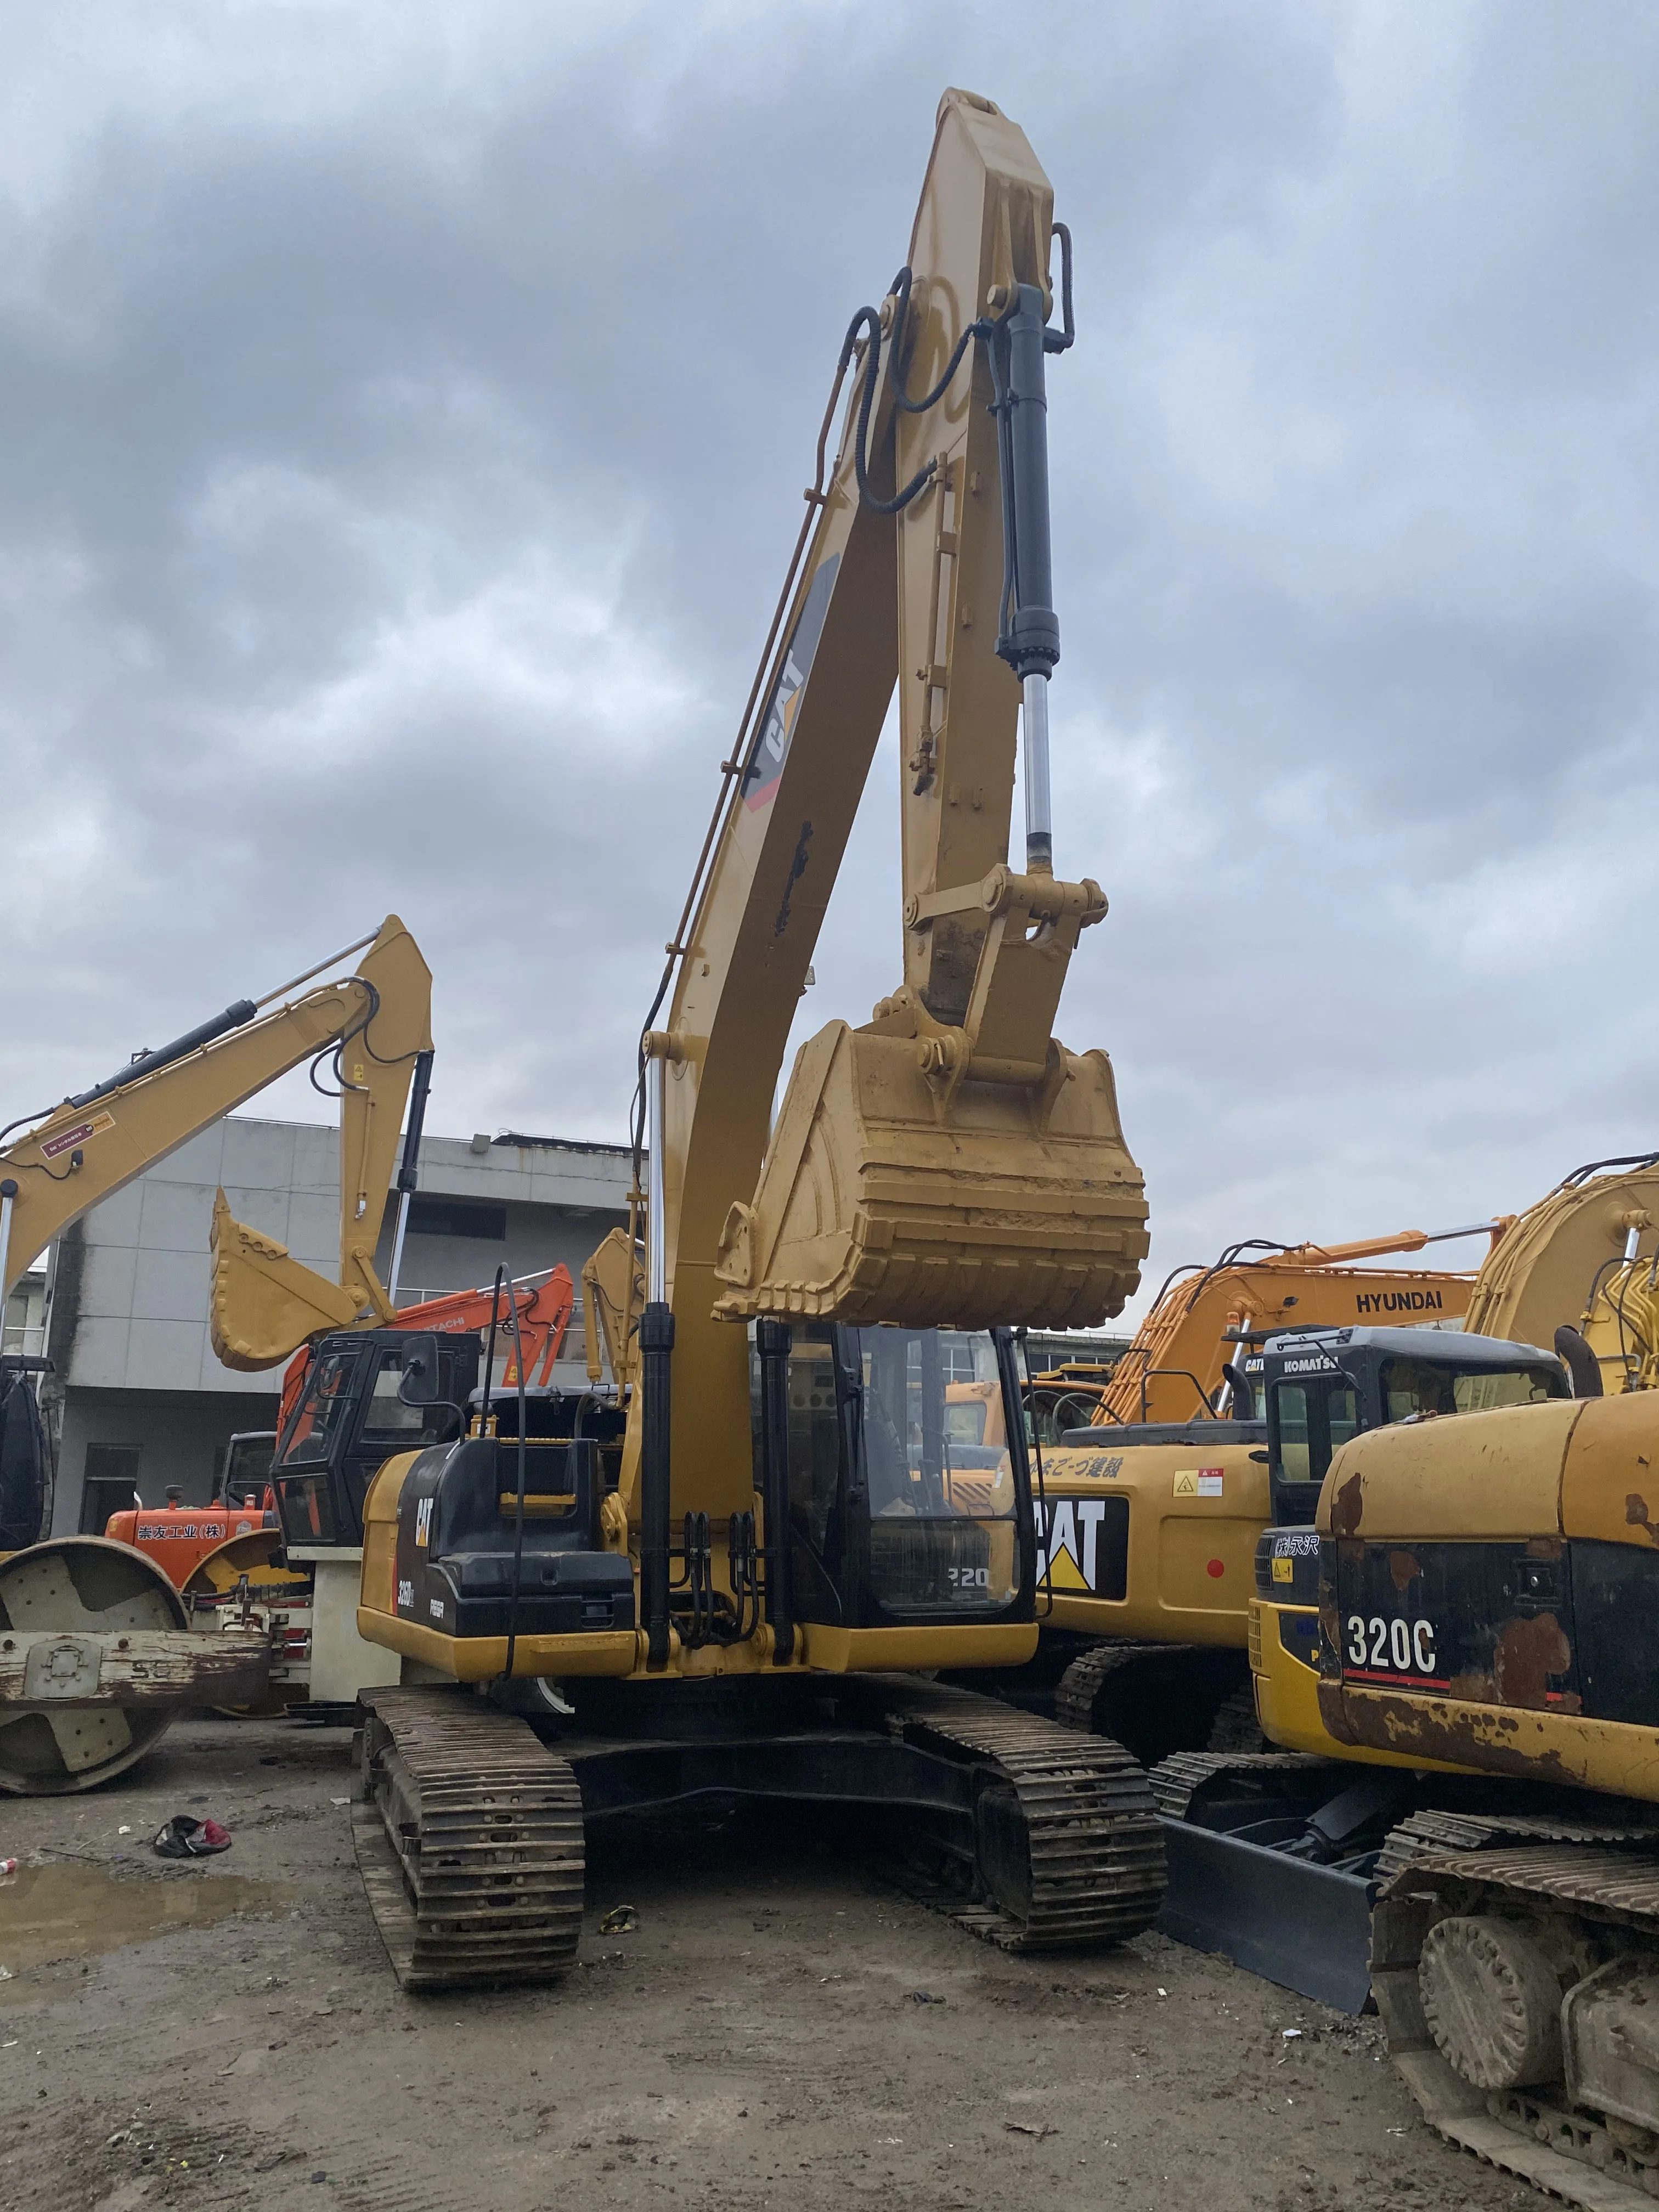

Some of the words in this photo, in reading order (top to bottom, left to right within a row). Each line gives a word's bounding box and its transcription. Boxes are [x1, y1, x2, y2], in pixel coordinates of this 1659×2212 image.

[766, 648, 804, 763] CAT
[1356, 1291, 1442, 1313] HYUNDAI
[1284, 1355, 1339, 1373] KOMATSU
[416, 1498, 433, 1547] CAT
[1348, 1616, 1435, 1672] 320C
